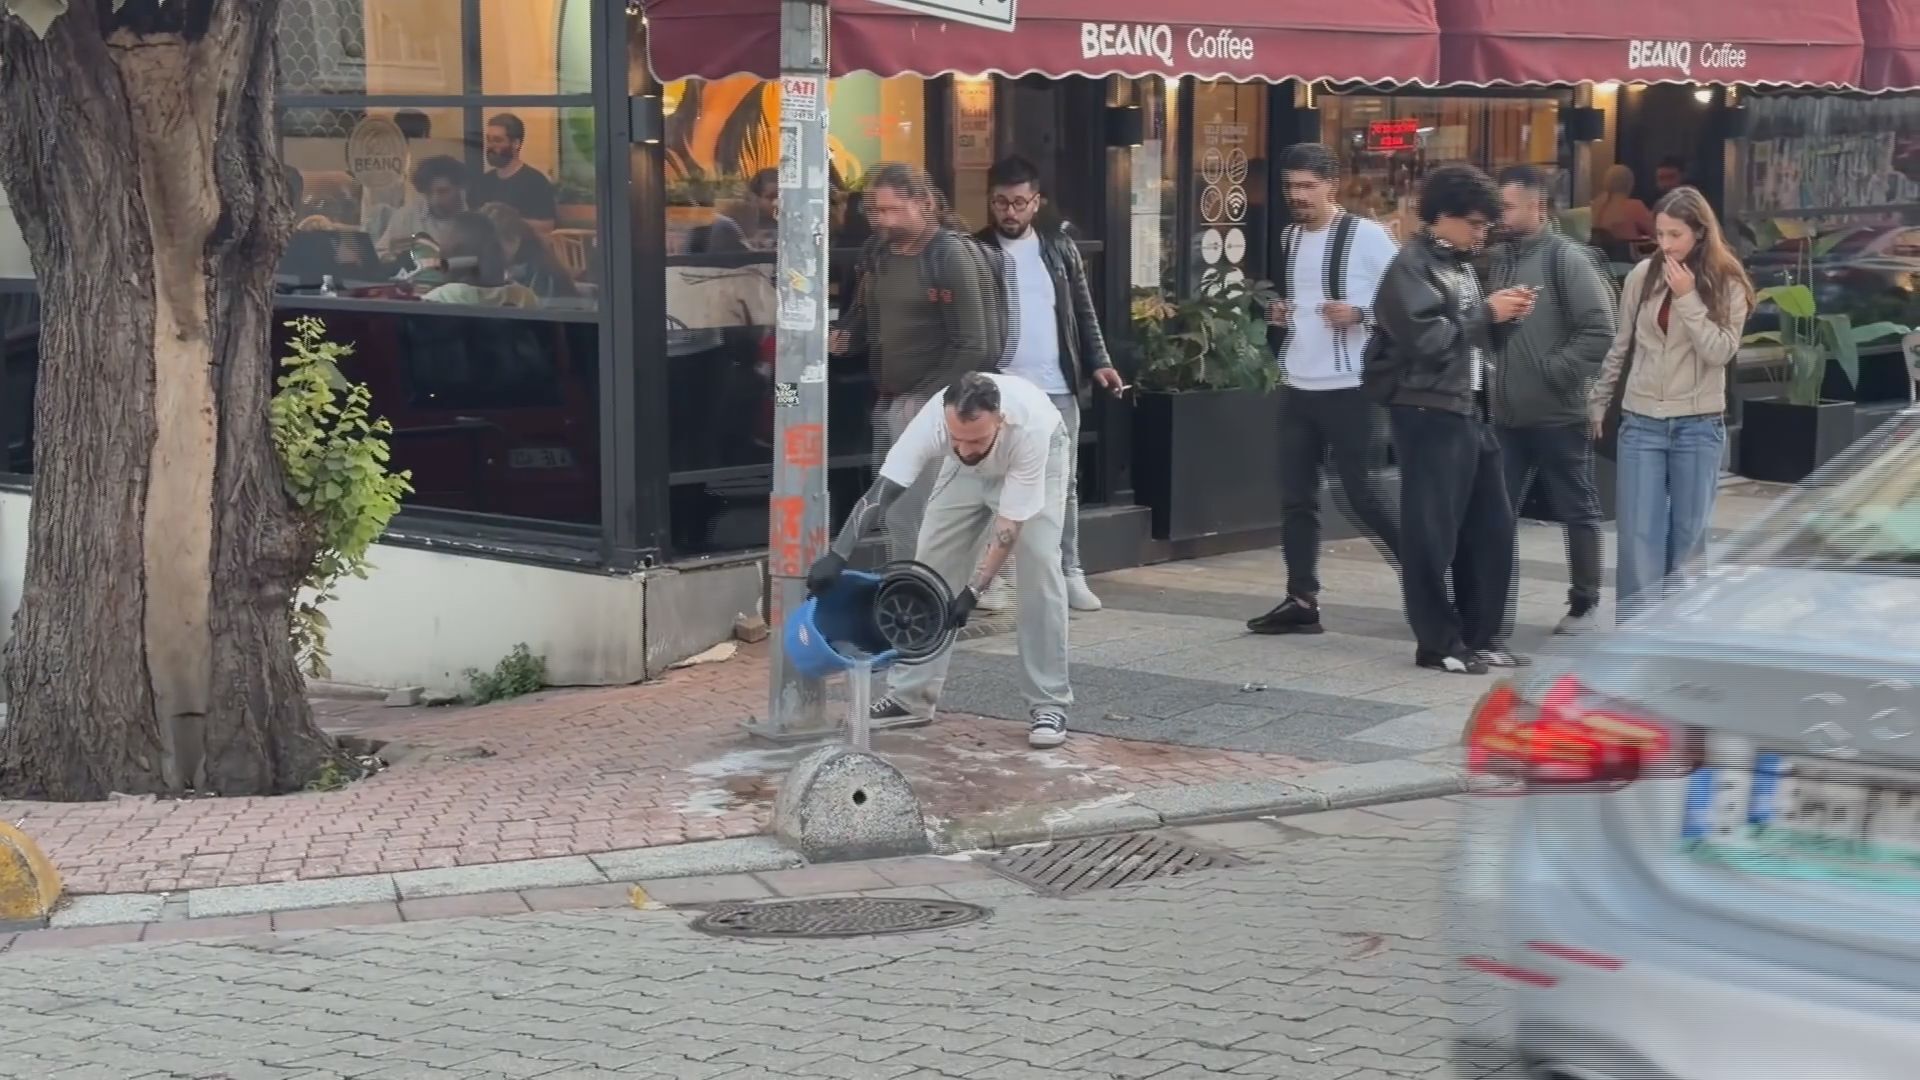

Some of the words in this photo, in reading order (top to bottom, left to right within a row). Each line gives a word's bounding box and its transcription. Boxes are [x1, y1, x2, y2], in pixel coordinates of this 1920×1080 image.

[1081, 22, 1174, 66] BEANQ
[1187, 28, 1255, 59] Coffee
[1629, 40, 1690, 75] BEANQ
[1700, 43, 1746, 68] Coffee
[354, 157, 402, 174] BEANQ
